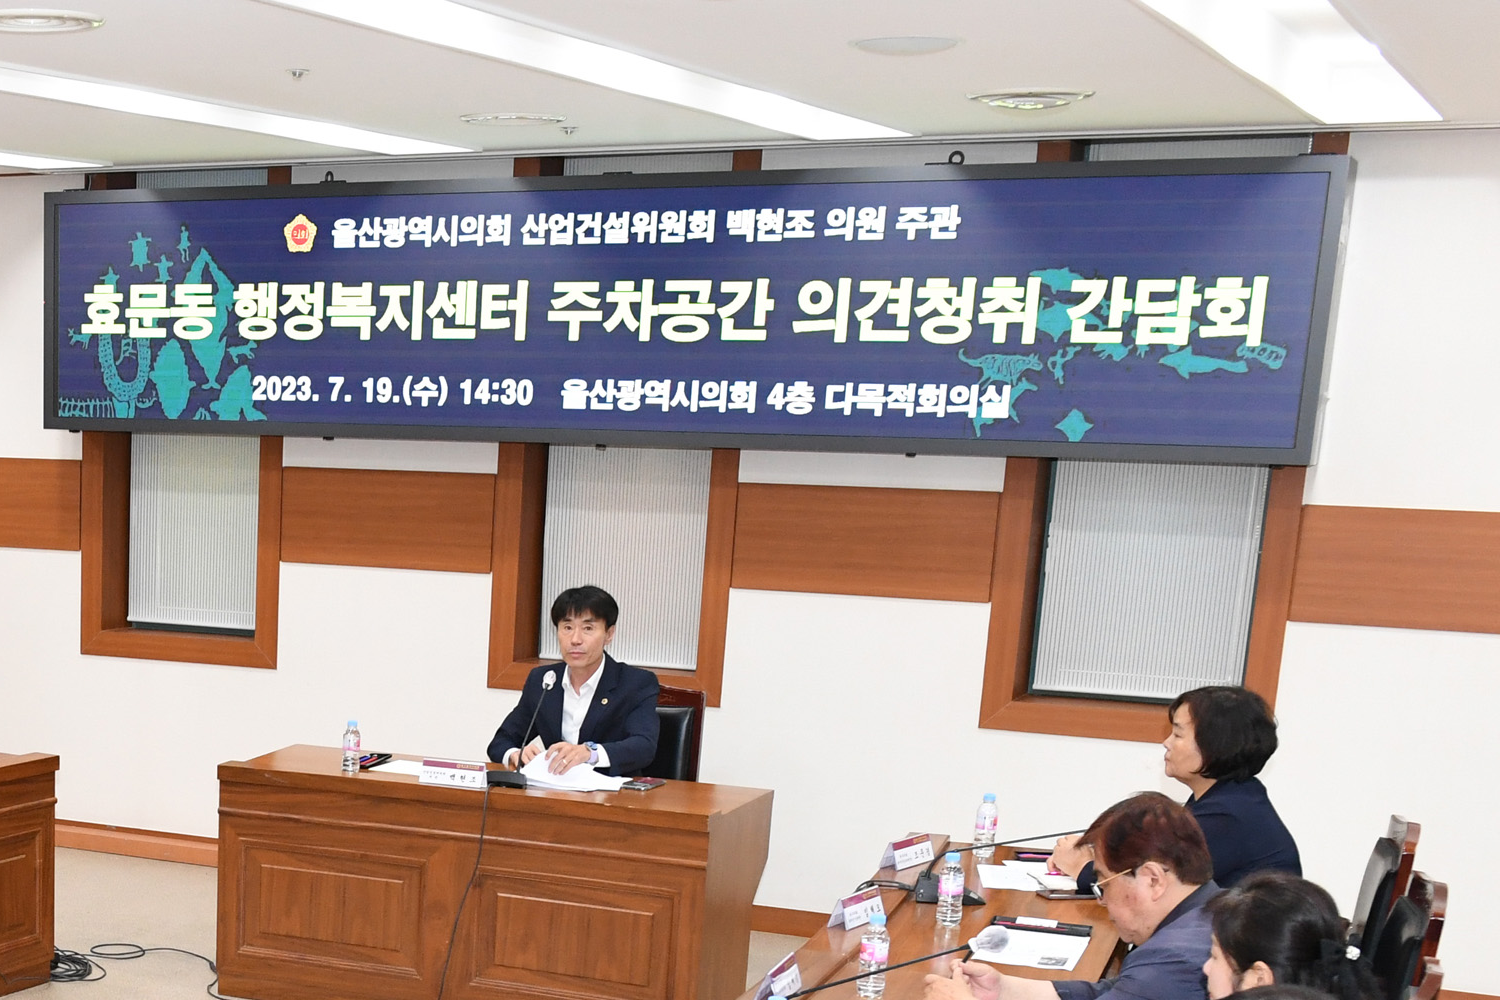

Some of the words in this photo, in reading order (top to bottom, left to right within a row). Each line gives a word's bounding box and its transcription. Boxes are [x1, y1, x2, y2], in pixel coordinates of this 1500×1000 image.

[331, 213, 512, 249] 울산광역시의회
[520, 209, 716, 246] 산업건설위원회
[726, 207, 816, 243] 백현조
[823, 205, 887, 242] 의원
[895, 204, 962, 241] 주관
[80, 283, 217, 341] 효문동
[232, 279, 530, 342] 행정복지센터
[547, 277, 775, 343] 주차공간
[792, 276, 1042, 345] 의견청취
[1066, 275, 1270, 348] 간담회
[251, 374, 320, 402] 2023.
[328, 376, 352, 403] 7.
[362, 375, 449, 407] 19.(수)
[459, 378, 534, 406] 14:30
[560, 378, 758, 414] 울산광역시의회
[766, 380, 816, 415] 4층
[824, 382, 1012, 419] 다목적회의실
